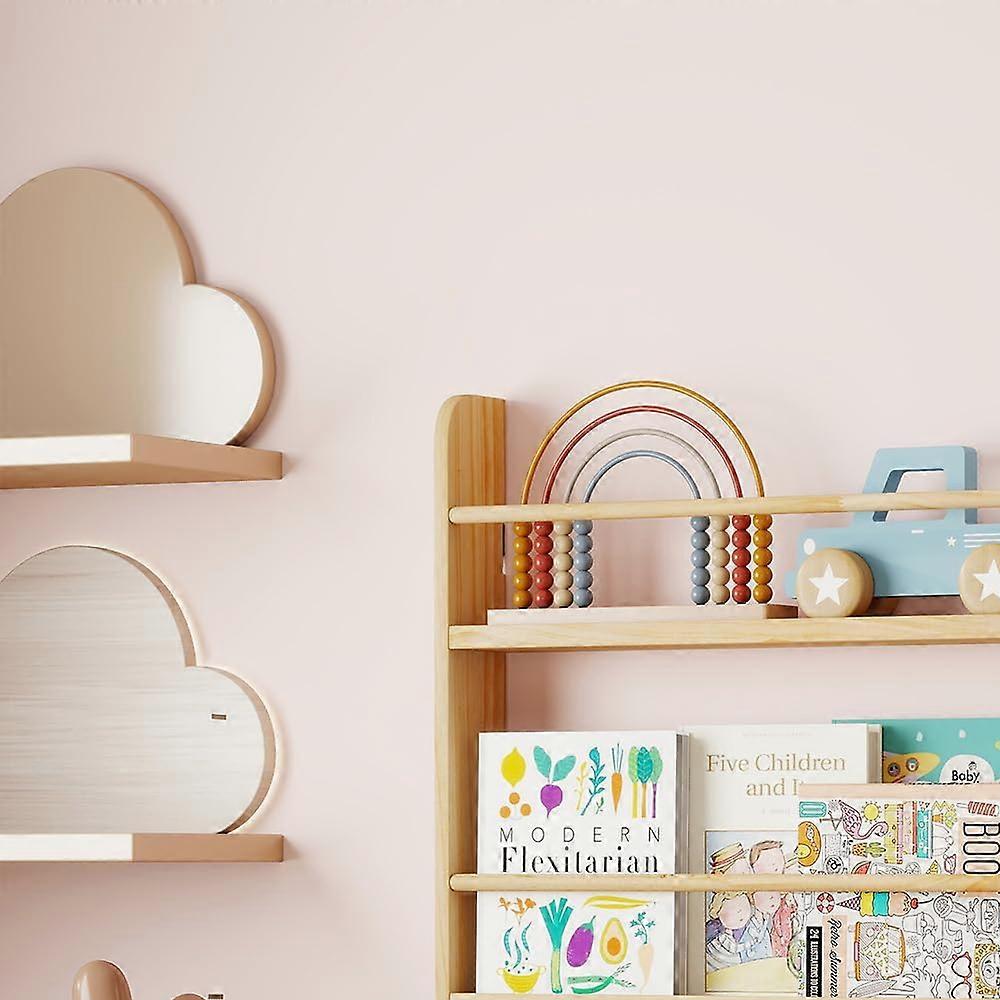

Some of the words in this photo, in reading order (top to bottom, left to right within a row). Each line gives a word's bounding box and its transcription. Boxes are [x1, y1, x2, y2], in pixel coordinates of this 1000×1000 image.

[706, 754, 749, 772] Five
[755, 753, 846, 772] Children
[746, 778, 785, 796] and
[793, 779, 804, 796] I
[952, 770, 981, 784] Baby
[499, 827, 660, 843] MODERN
[502, 846, 659, 874] Flexitarian
[963, 822, 1000, 893] BOO
[827, 917, 842, 948] Retro
[828, 950, 842, 998] Summer
